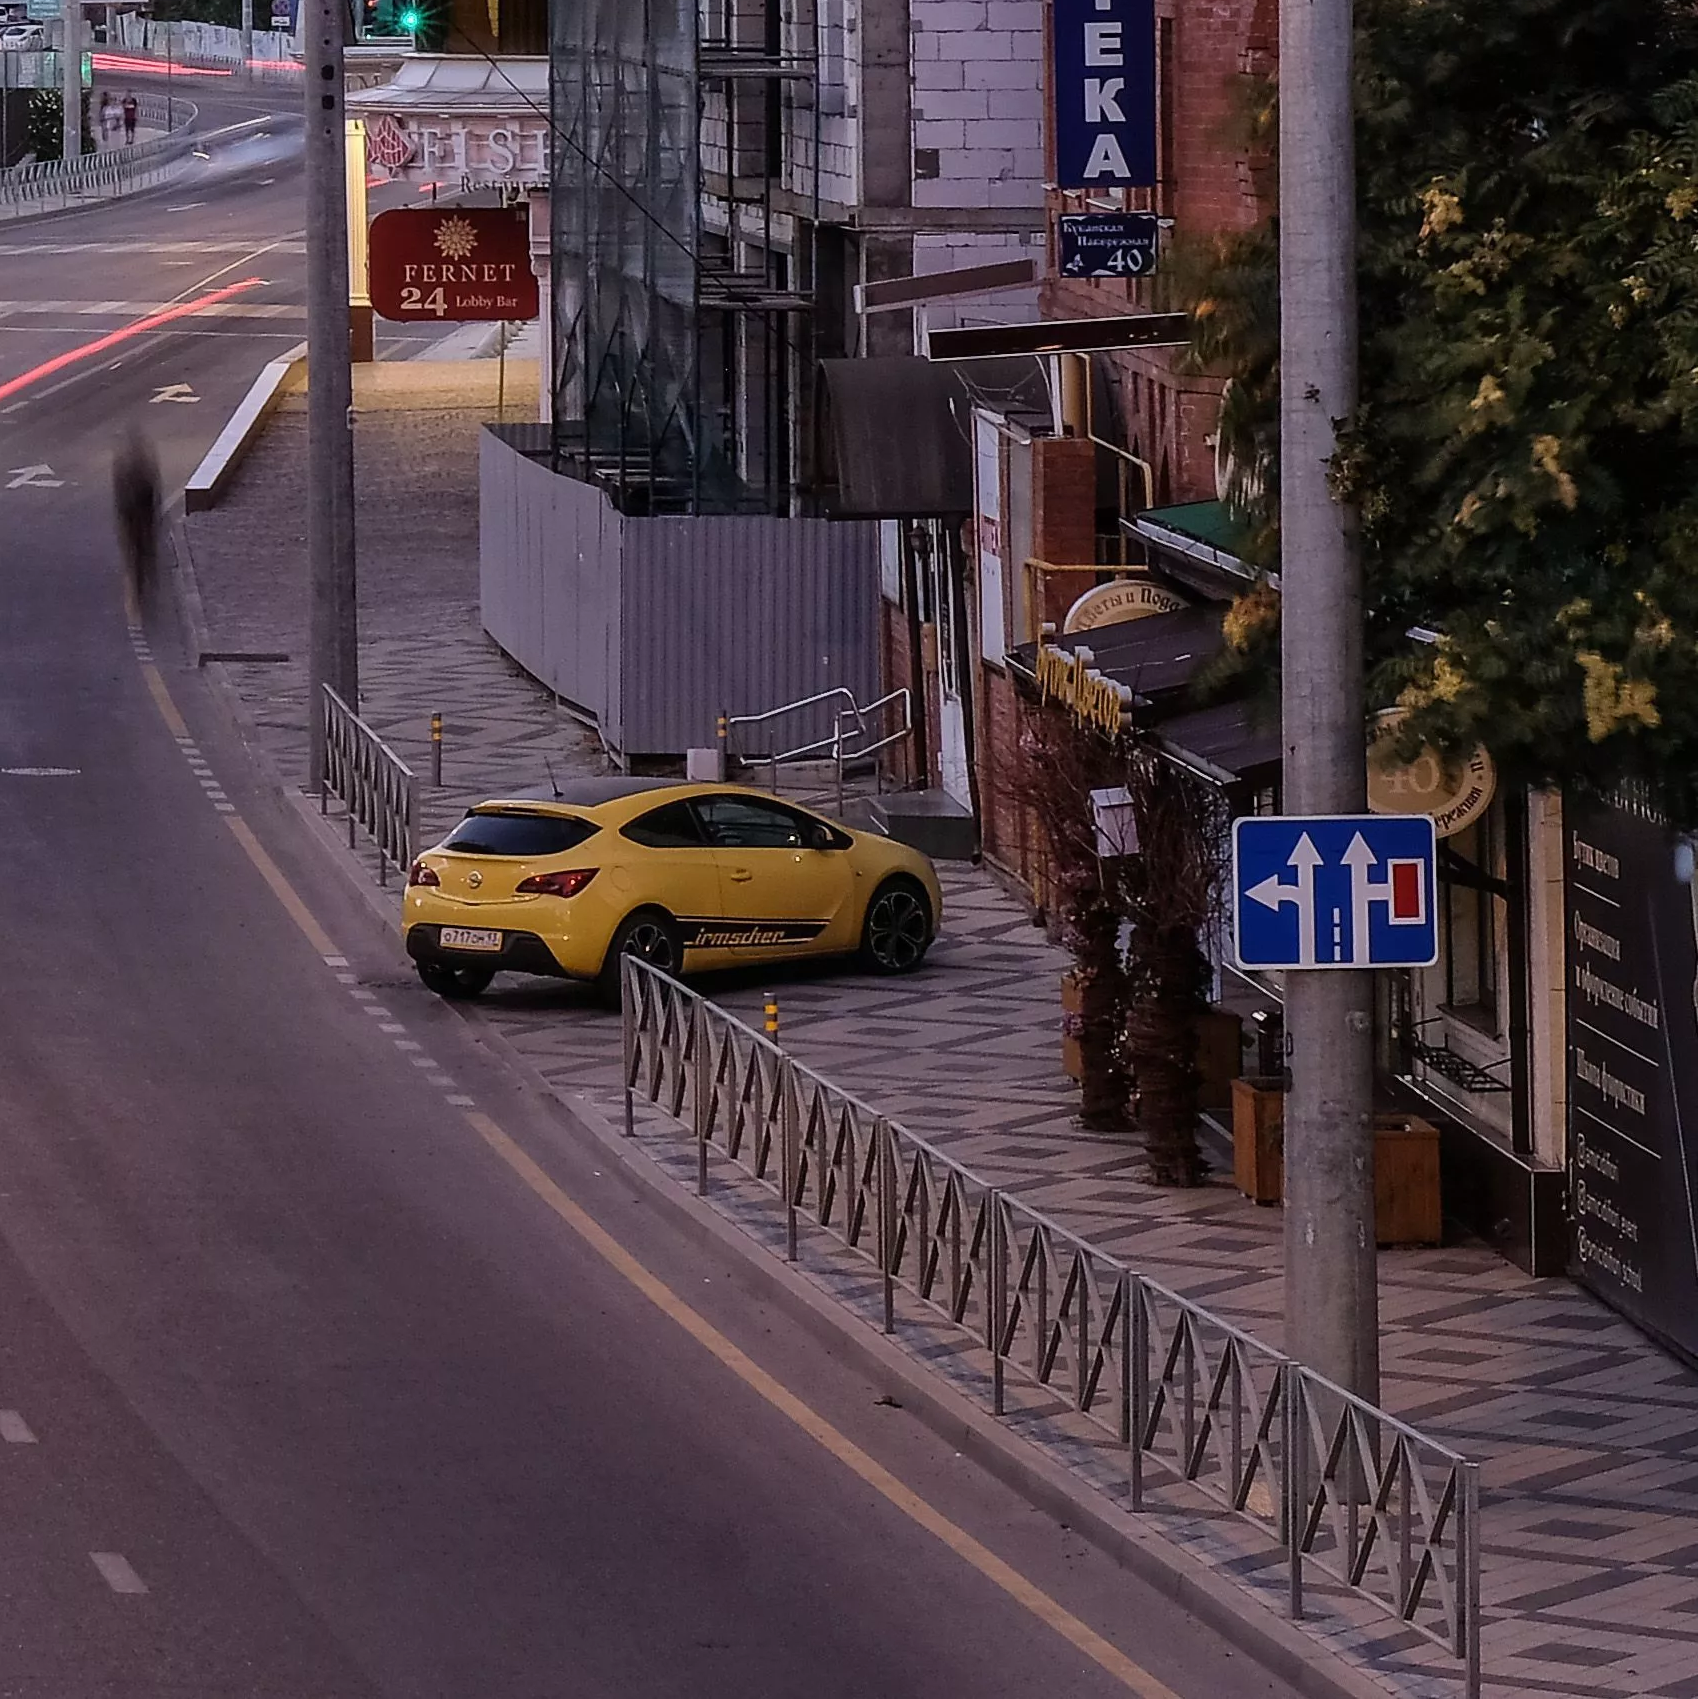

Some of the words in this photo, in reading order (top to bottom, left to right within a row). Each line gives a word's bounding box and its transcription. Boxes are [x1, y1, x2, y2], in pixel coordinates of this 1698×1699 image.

[1063, 222, 1125, 236] Кубанская
[1077, 236, 1150, 249] Набережная
[1106, 248, 1143, 272] 40
[403, 263, 517, 283] FERNET
[399, 286, 448, 317] 24
[455, 294, 493, 310] Lobby
[496, 294, 518, 308] Bar
[1126, 592, 1135, 604] и
[1140, 587, 1182, 612] Пода
[1433, 785, 1485, 831] ережная
[694, 928, 786, 947] irmscher
